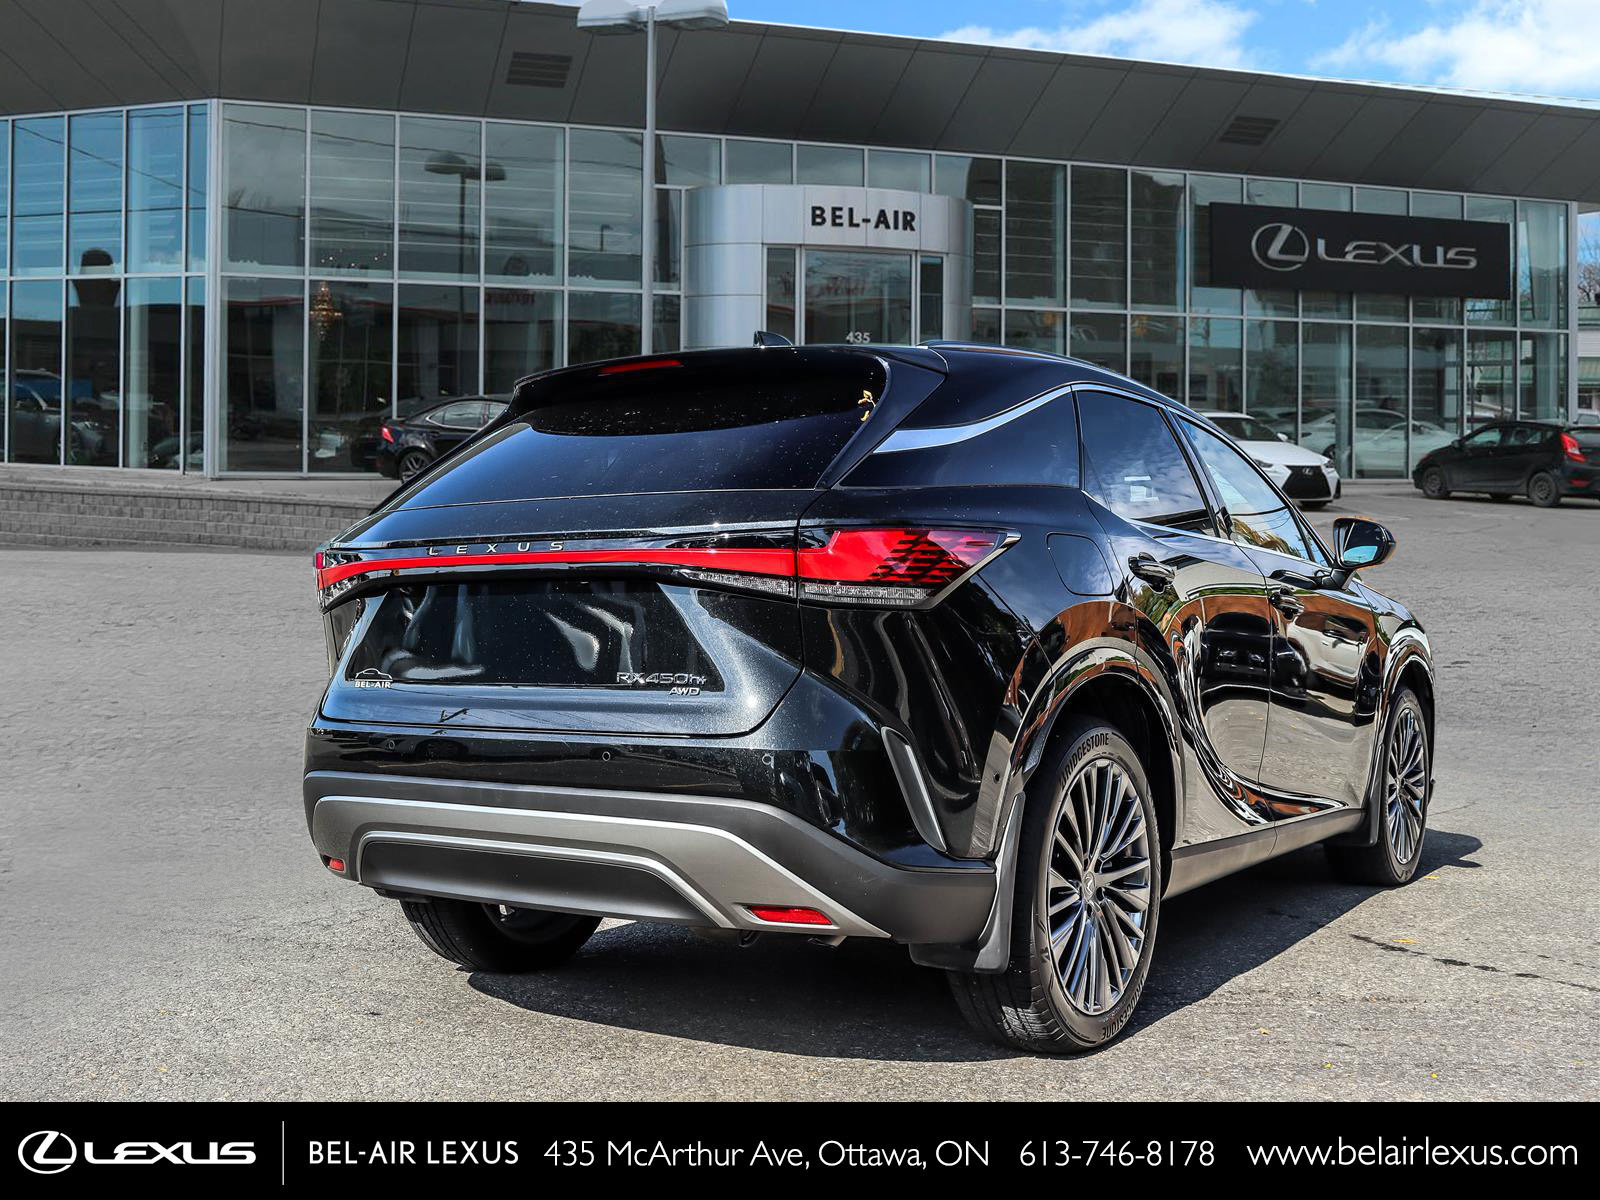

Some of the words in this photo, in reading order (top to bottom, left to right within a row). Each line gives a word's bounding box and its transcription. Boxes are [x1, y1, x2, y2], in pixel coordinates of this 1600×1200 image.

[811, 206, 916, 232] BEL-AIR
[1317, 238, 1477, 269] LEXUS
[846, 331, 870, 344] 435
[429, 541, 564, 556] LEXUS
[669, 687, 700, 696] AWD
